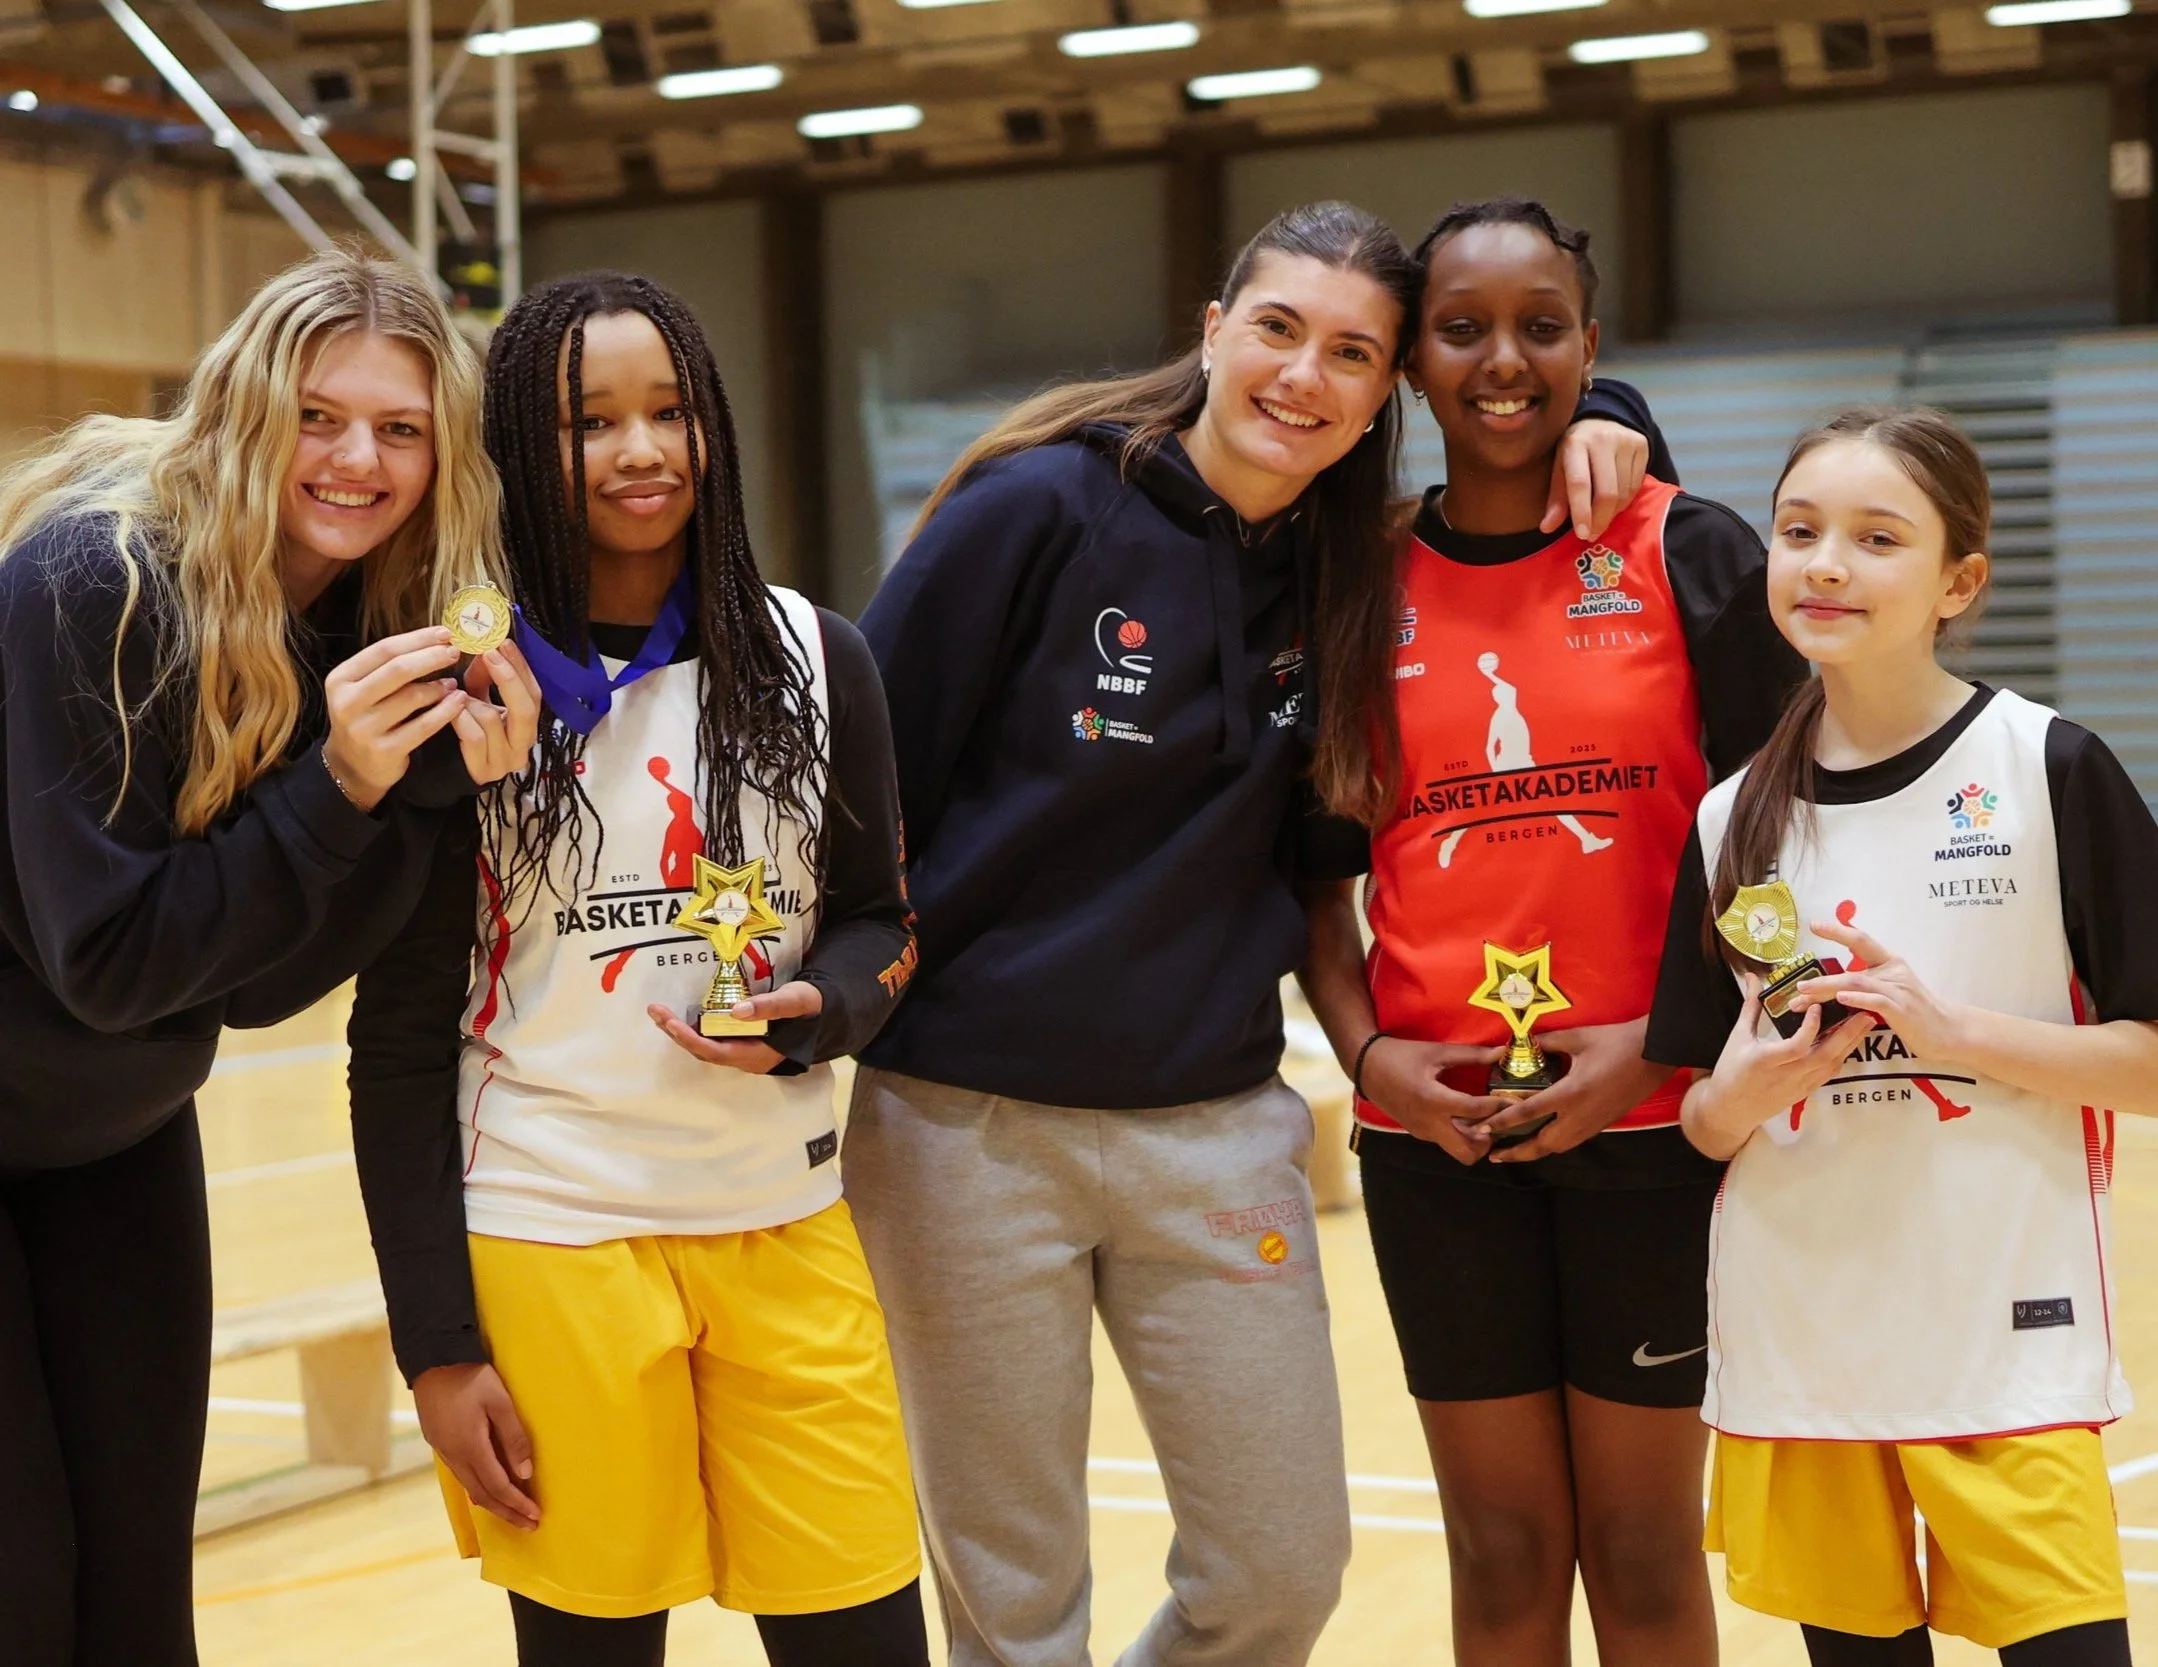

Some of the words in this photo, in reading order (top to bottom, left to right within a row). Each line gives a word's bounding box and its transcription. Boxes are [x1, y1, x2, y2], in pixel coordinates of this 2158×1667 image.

[1568, 600, 1641, 617] MANGFOLD
[1096, 673, 1148, 696] NBBF
[1109, 720, 1135, 731] BASKET
[1108, 728, 1154, 744] MANGFOLD
[1443, 760, 1469, 772] ESTD
[1486, 825, 1558, 844] BERGEN
[1950, 833, 1987, 846] BASKET
[1934, 844, 2012, 862] MANGFOLD
[611, 873, 641, 884] ESTD
[1928, 878, 2018, 899] METEVA
[1943, 900, 1967, 908] SPORT
[1982, 898, 2004, 906] HELSE
[656, 950, 720, 967] BERGE
[1832, 1089, 1912, 1105] BERGEN
